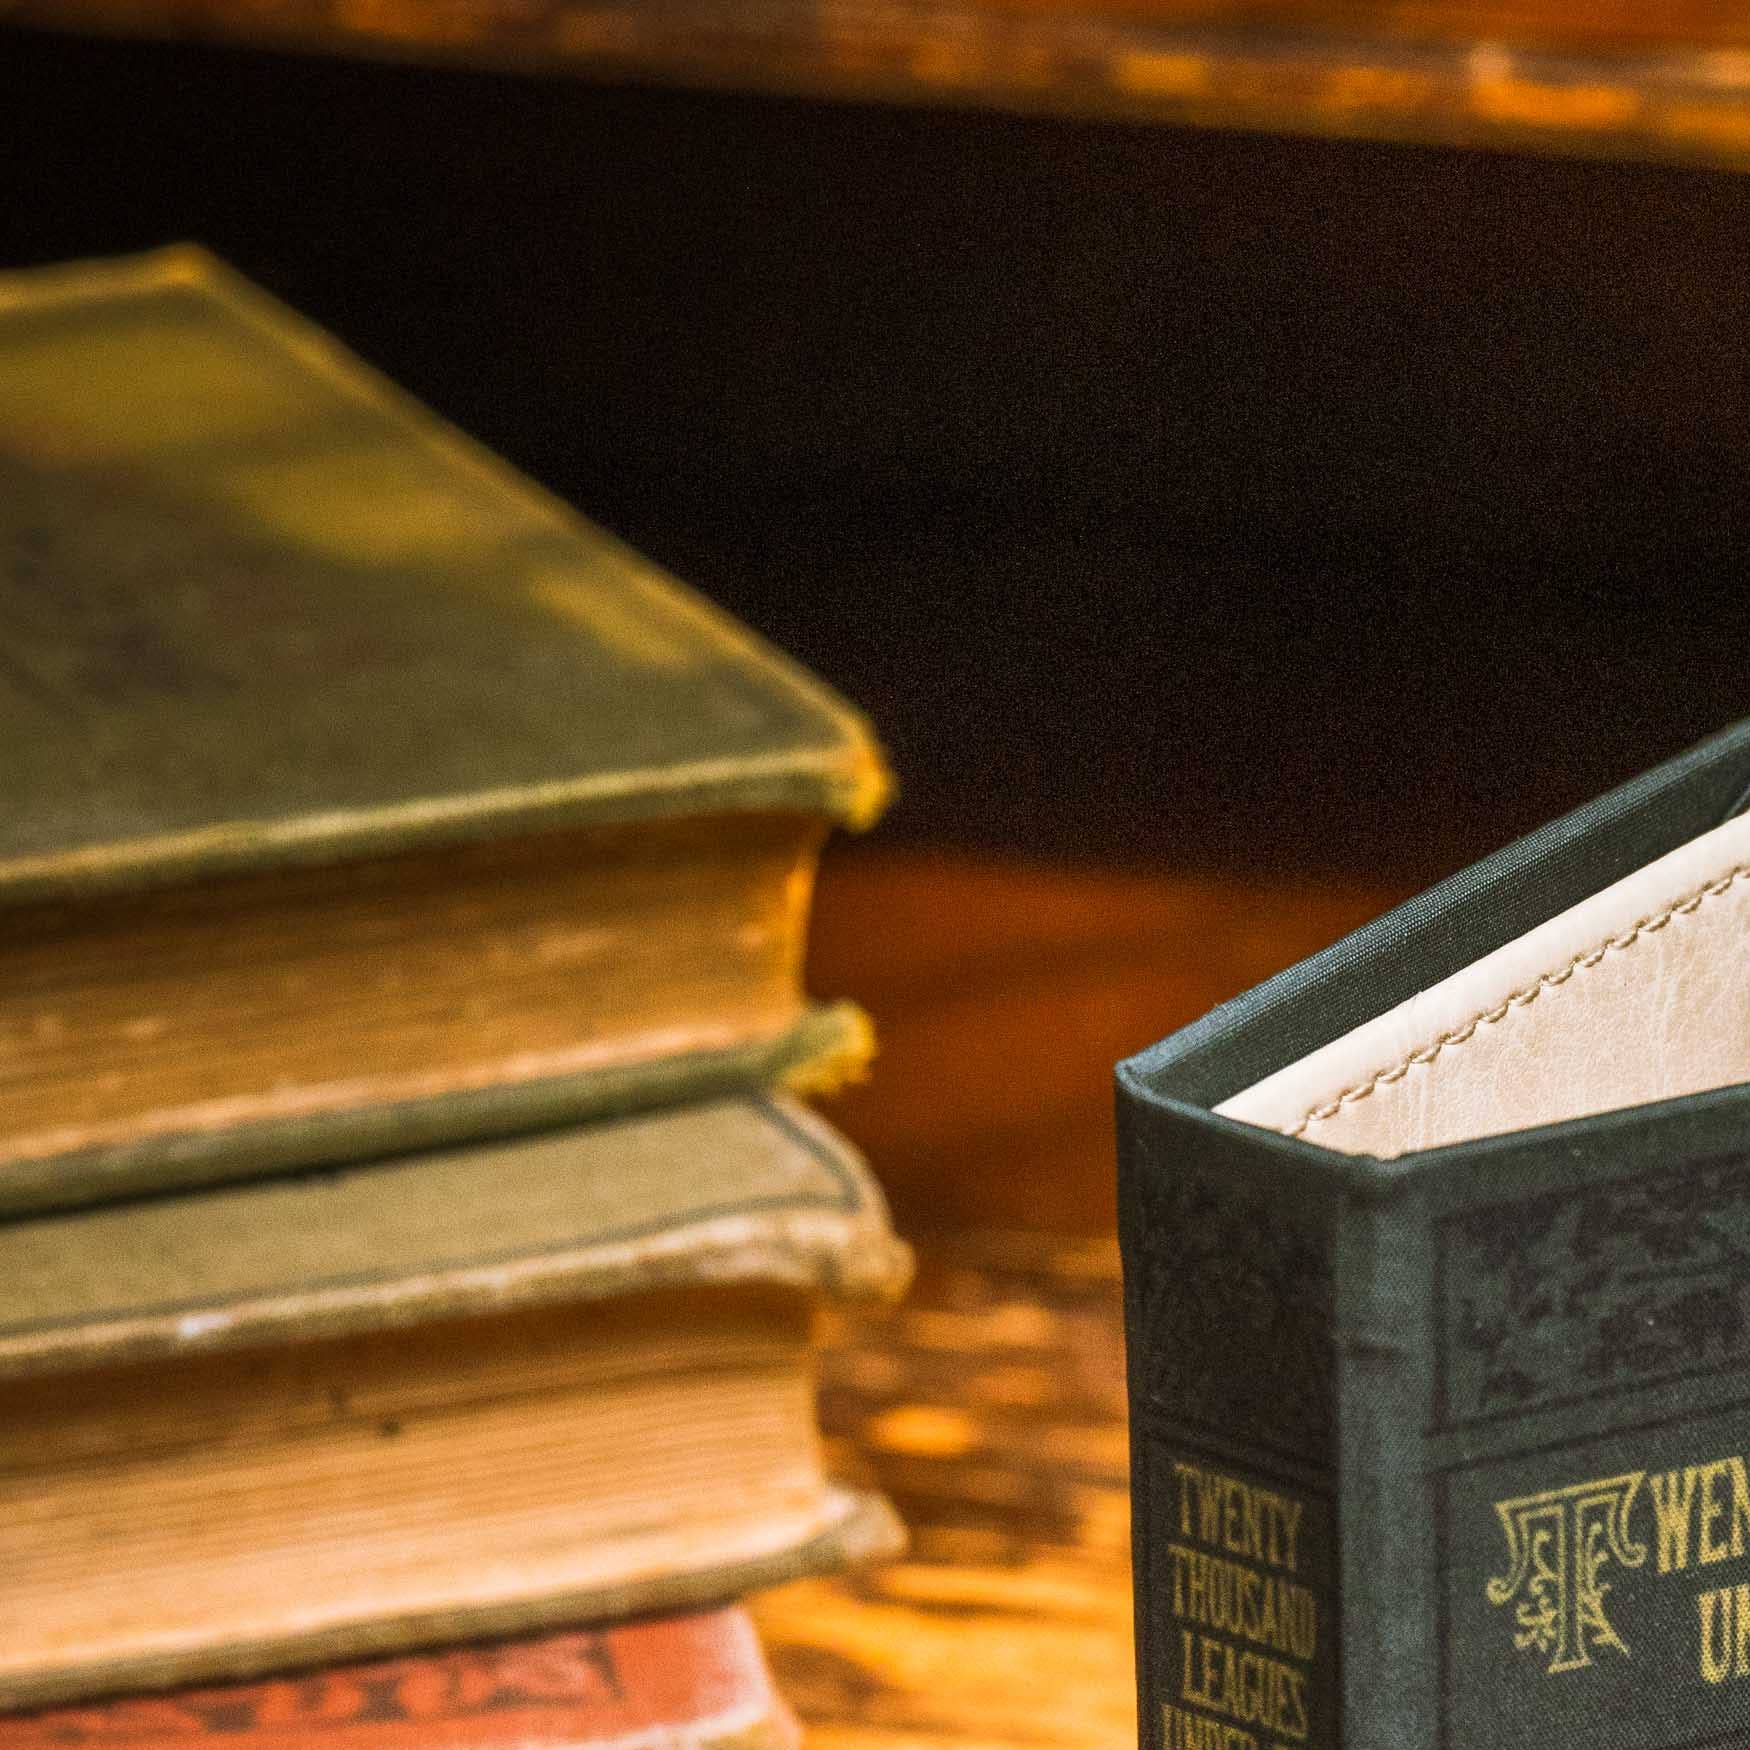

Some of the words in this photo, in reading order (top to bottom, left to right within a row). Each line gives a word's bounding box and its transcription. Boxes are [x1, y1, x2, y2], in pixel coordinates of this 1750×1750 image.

[1174, 1463, 1301, 1572] TWENTY
[1168, 1544, 1316, 1660] THOUSAND
[1180, 1630, 1309, 1739] LEAGUES
